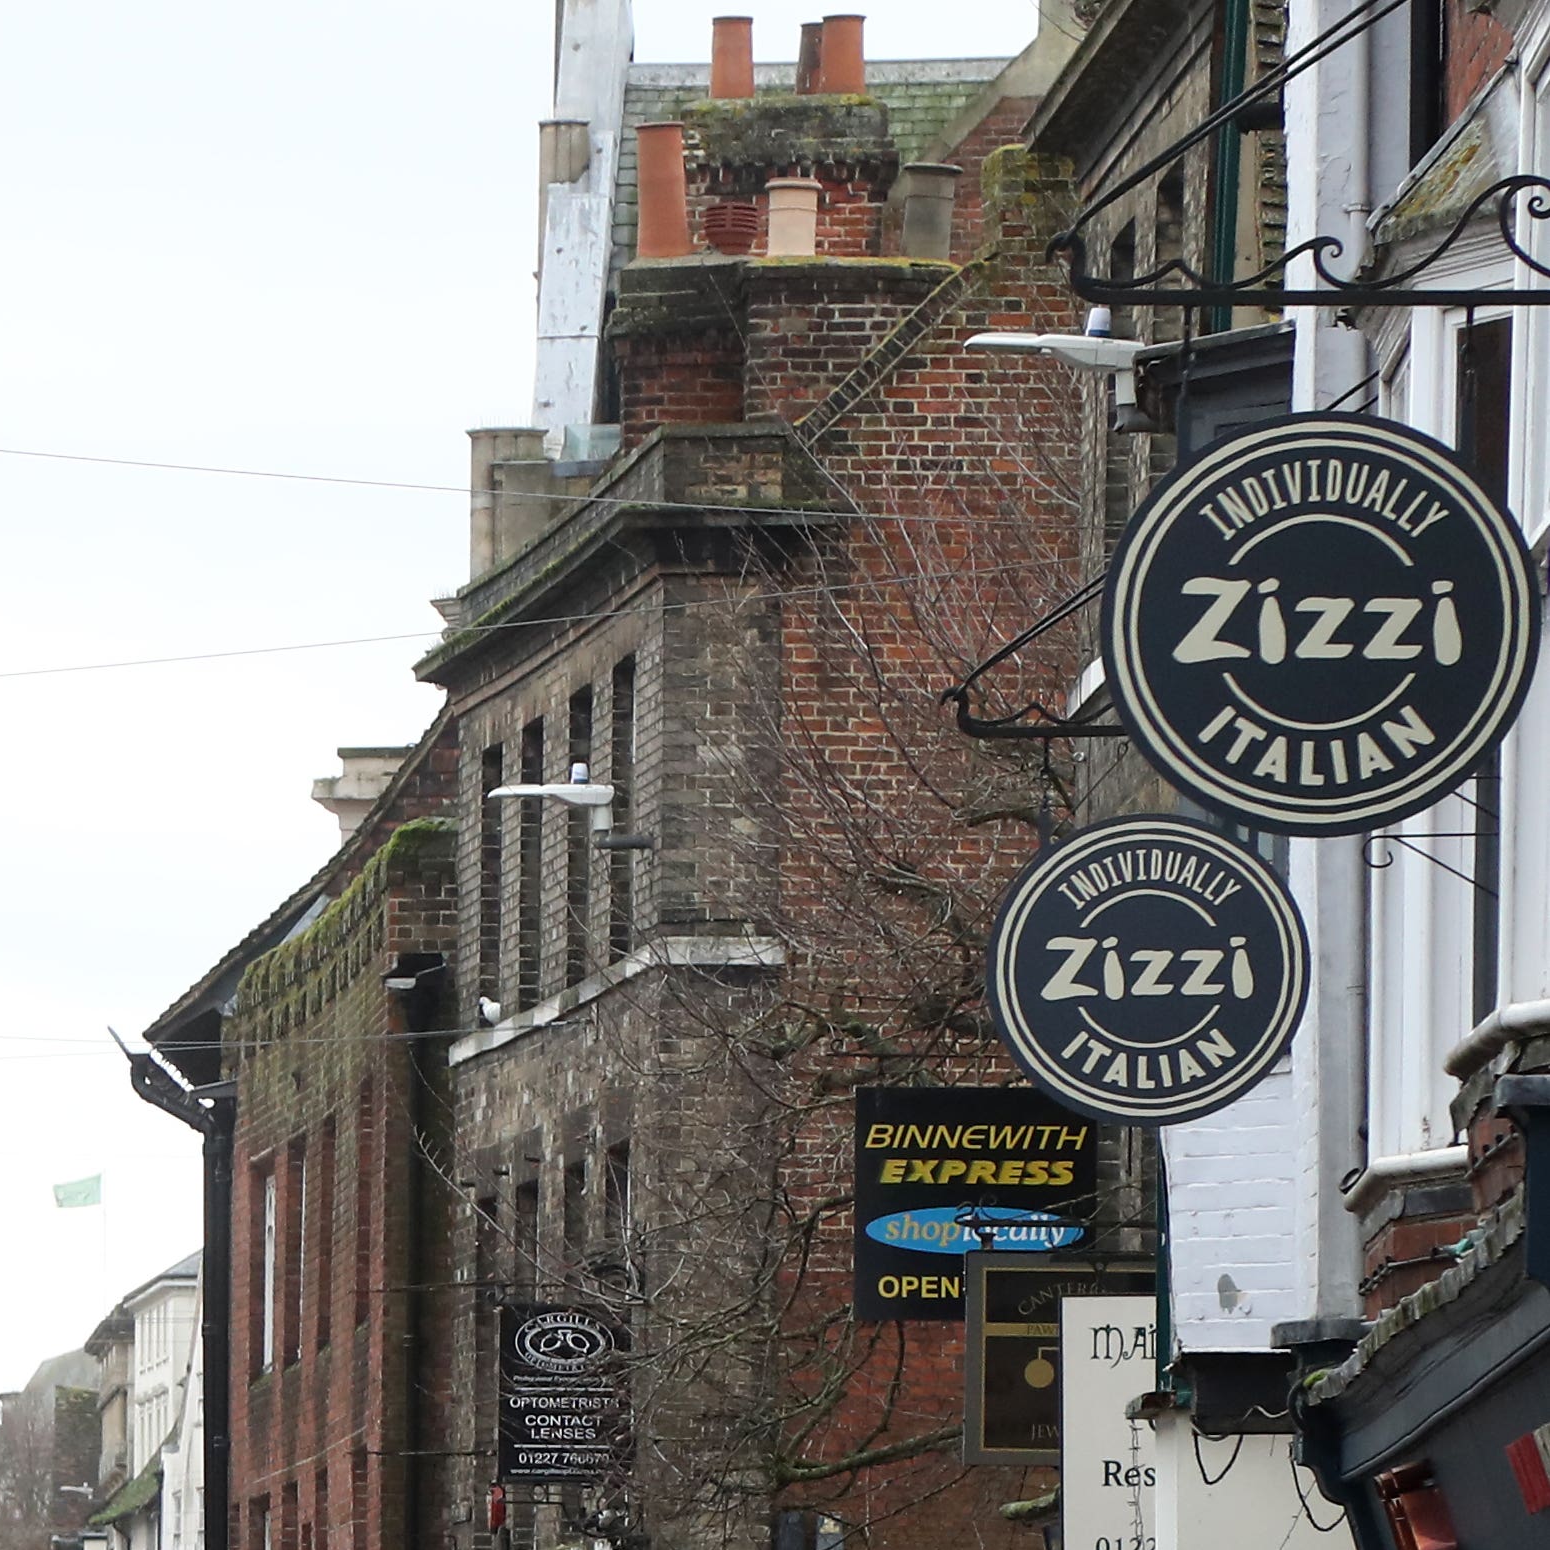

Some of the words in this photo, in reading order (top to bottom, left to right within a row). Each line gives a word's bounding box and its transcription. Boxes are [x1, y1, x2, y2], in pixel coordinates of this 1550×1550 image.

[1199, 459, 1449, 541] INDIVIDUALLY
[1171, 576, 1463, 666] Zizzi
[1198, 705, 1436, 787] ITALIAN
[1057, 849, 1242, 910] INDIVIDUALLY
[1040, 936, 1254, 1001] Zizzi
[1061, 1028, 1237, 1089] ITALIAN
[865, 1124, 1088, 1150] BINNEWITH
[879, 1159, 1075, 1185] EXPRESS
[878, 1275, 959, 1299] OPEN
[525, 1414, 603, 1427] CONTACT
[531, 1427, 597, 1440] LENSES
[518, 1453, 558, 1464] 01227
